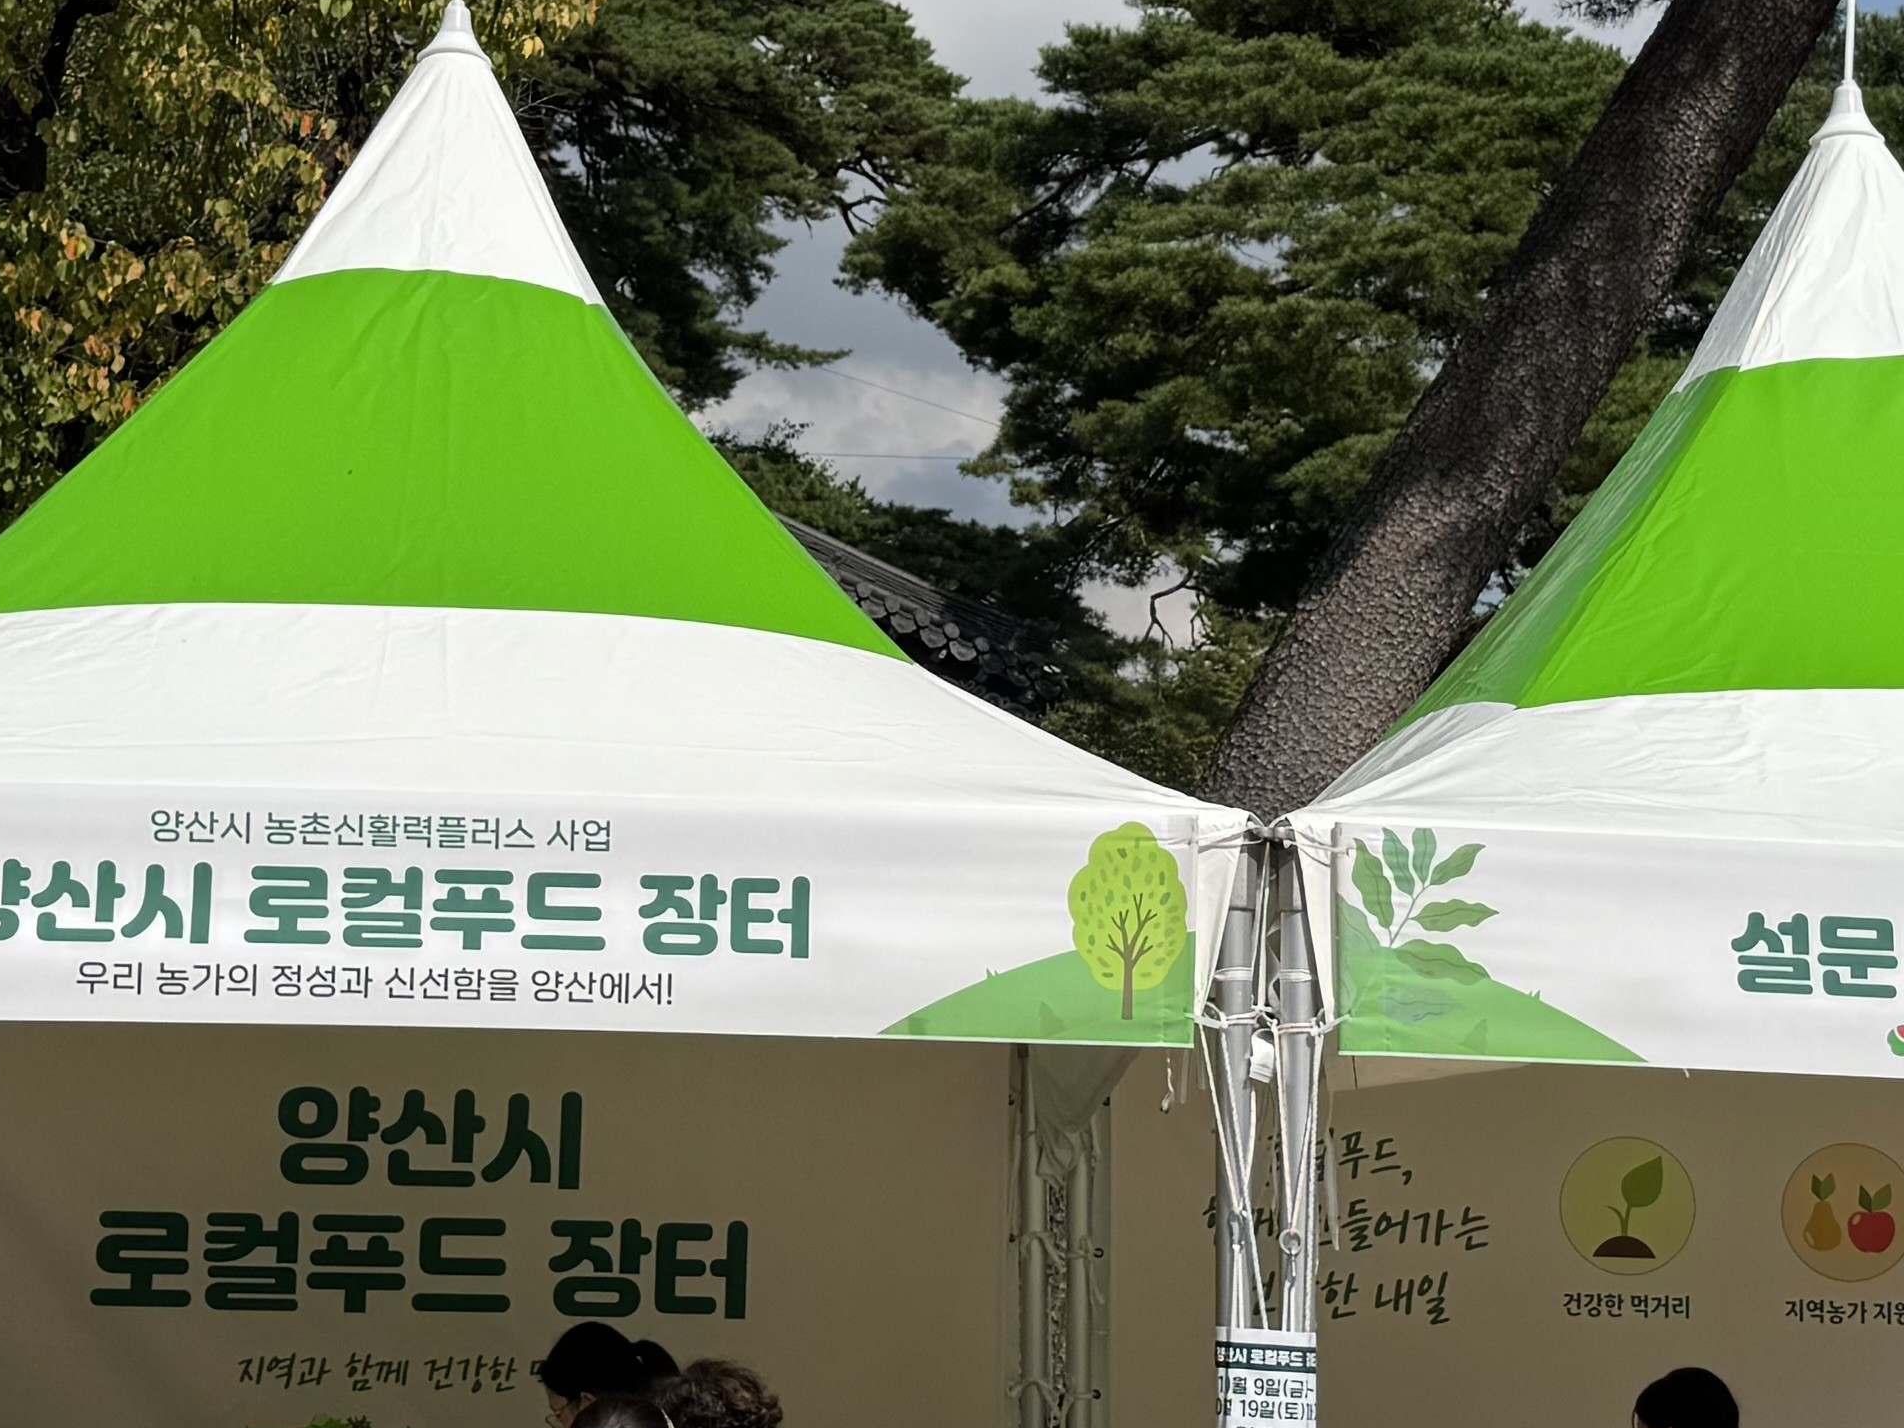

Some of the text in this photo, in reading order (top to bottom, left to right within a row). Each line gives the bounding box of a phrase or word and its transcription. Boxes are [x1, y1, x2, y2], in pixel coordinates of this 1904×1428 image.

[150, 807, 613, 853] 양산시 농촌신활력플러스 사업
[240, 861, 607, 954] 로컬푸드
[636, 871, 812, 960] 장터
[75, 960, 676, 1009] 우리 농가의 정성과 신선함을 양산에서!
[276, 1084, 586, 1191] 양산시
[88, 1208, 751, 1322] 로컬푸드 장터
[1374, 1271, 1450, 1324] 내일
[1561, 1291, 1692, 1321] 건강한 먹거리
[1784, 1297, 1868, 1327] 지역농가
[238, 1352, 332, 1390] 지역과
[344, 1351, 408, 1392] 함께
[423, 1354, 518, 1394] 건강한
